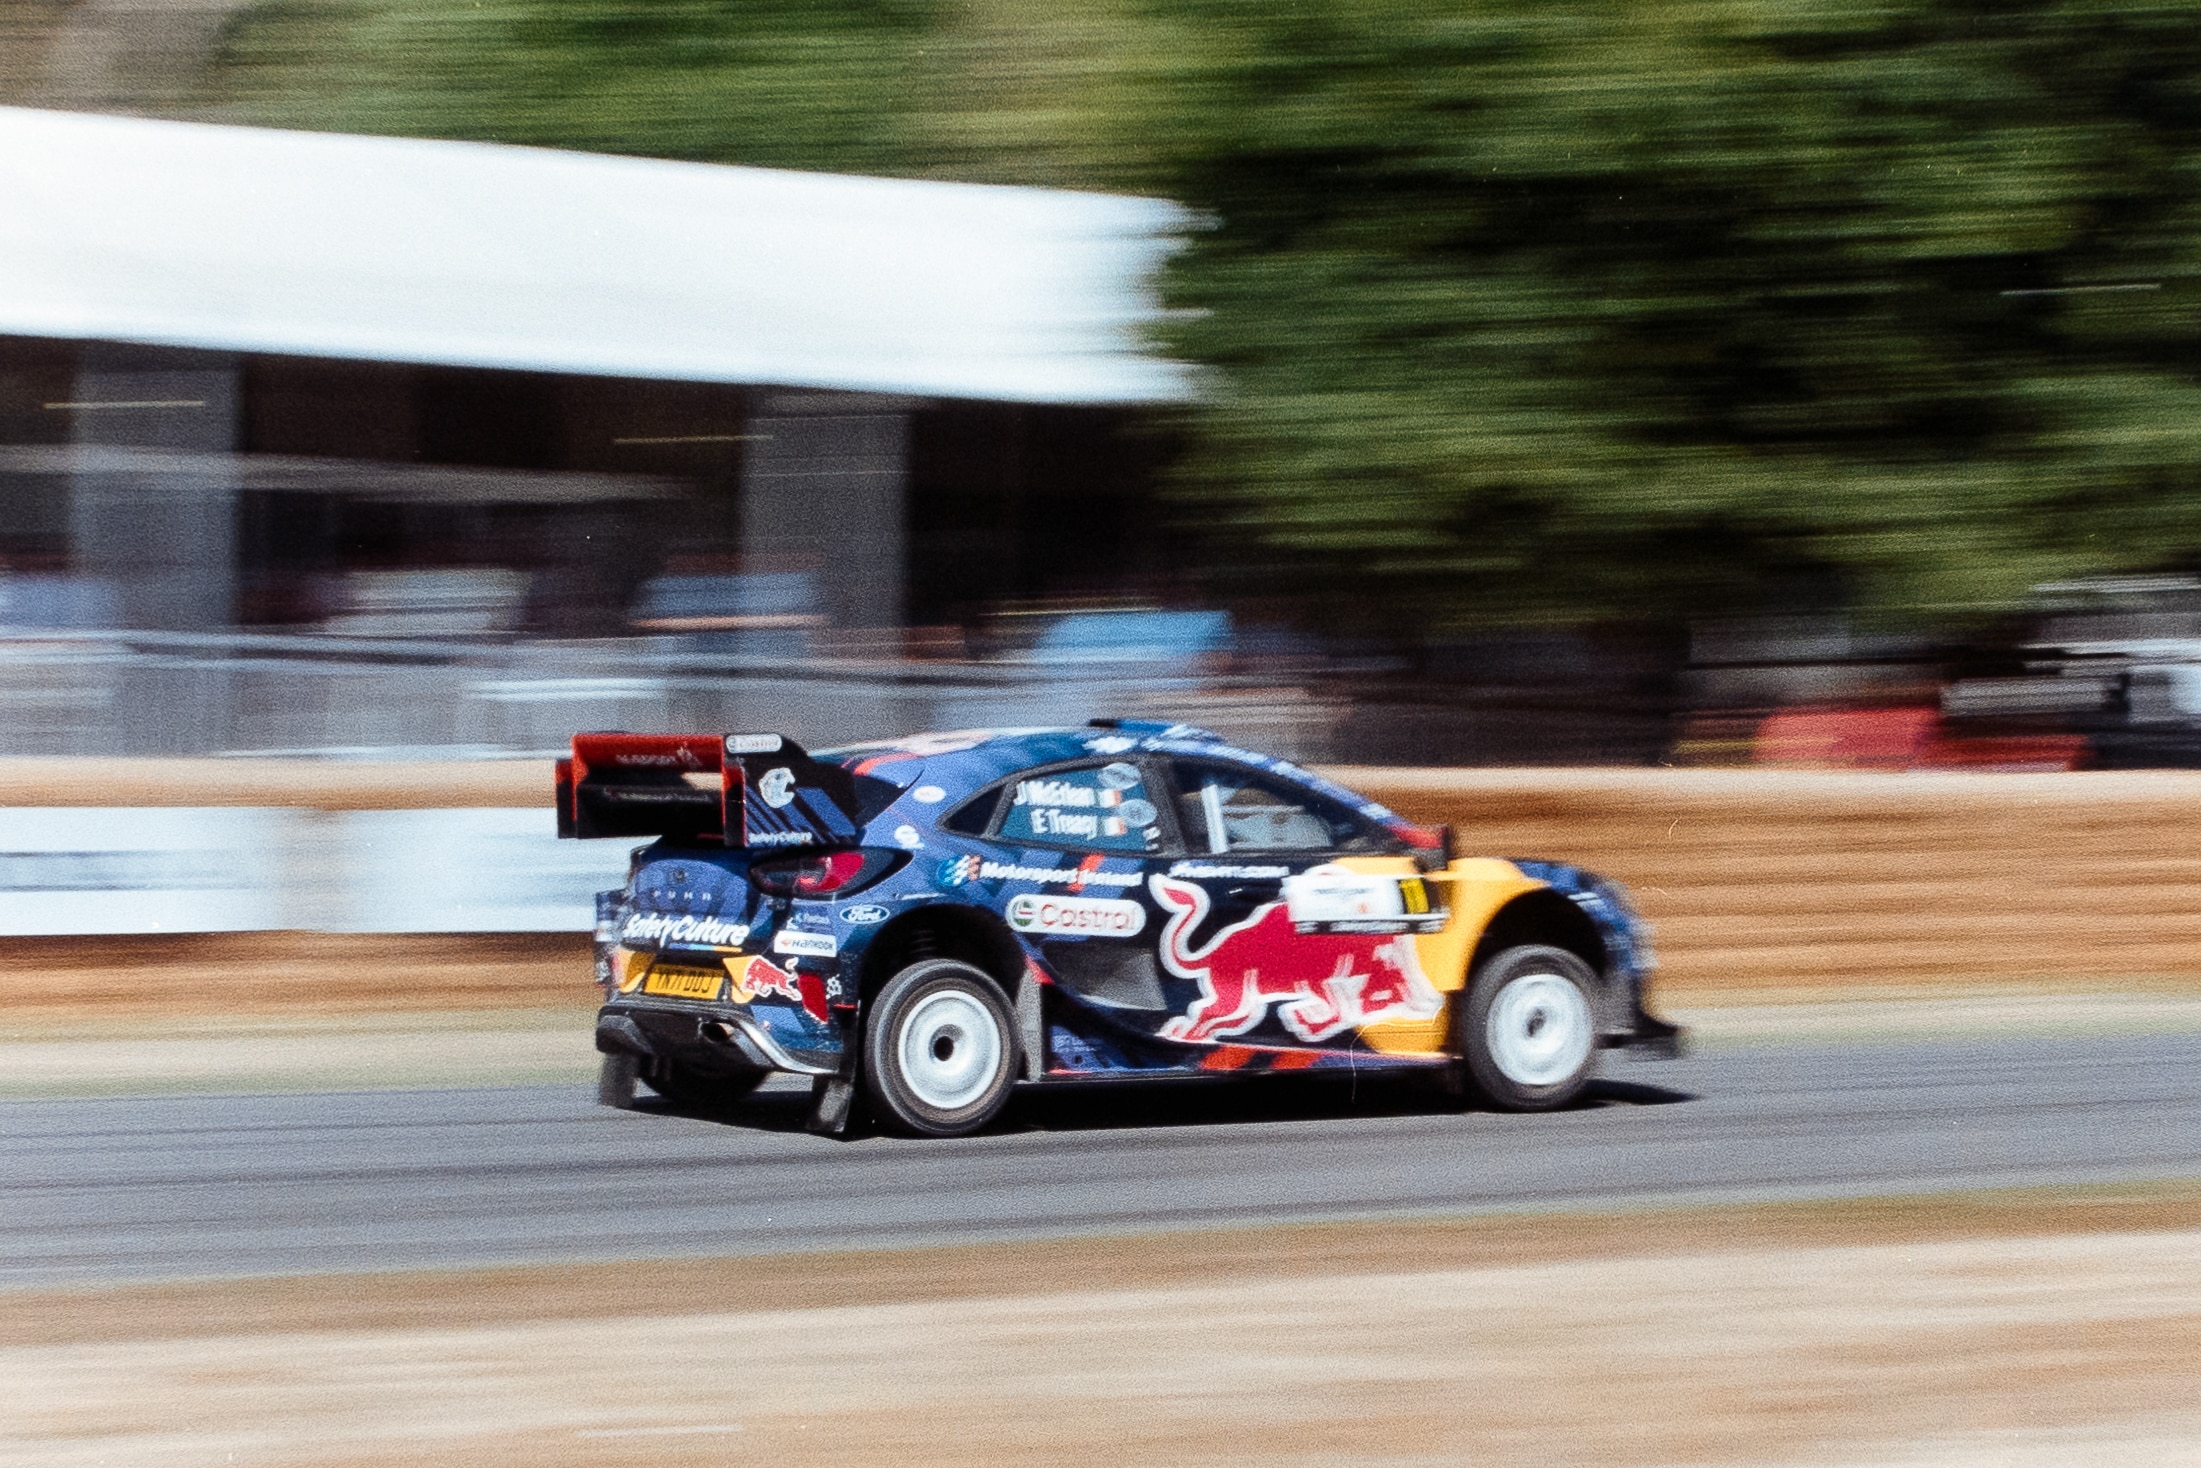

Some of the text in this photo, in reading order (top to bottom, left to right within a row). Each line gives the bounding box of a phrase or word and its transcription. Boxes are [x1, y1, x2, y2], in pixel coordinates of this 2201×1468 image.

[1032, 809, 1047, 834] E
[980, 861, 1079, 884] Motorsport
[847, 904, 881, 922] Ford
[1039, 902, 1137, 931] Castrol
[622, 912, 750, 948] SafetyCulture
